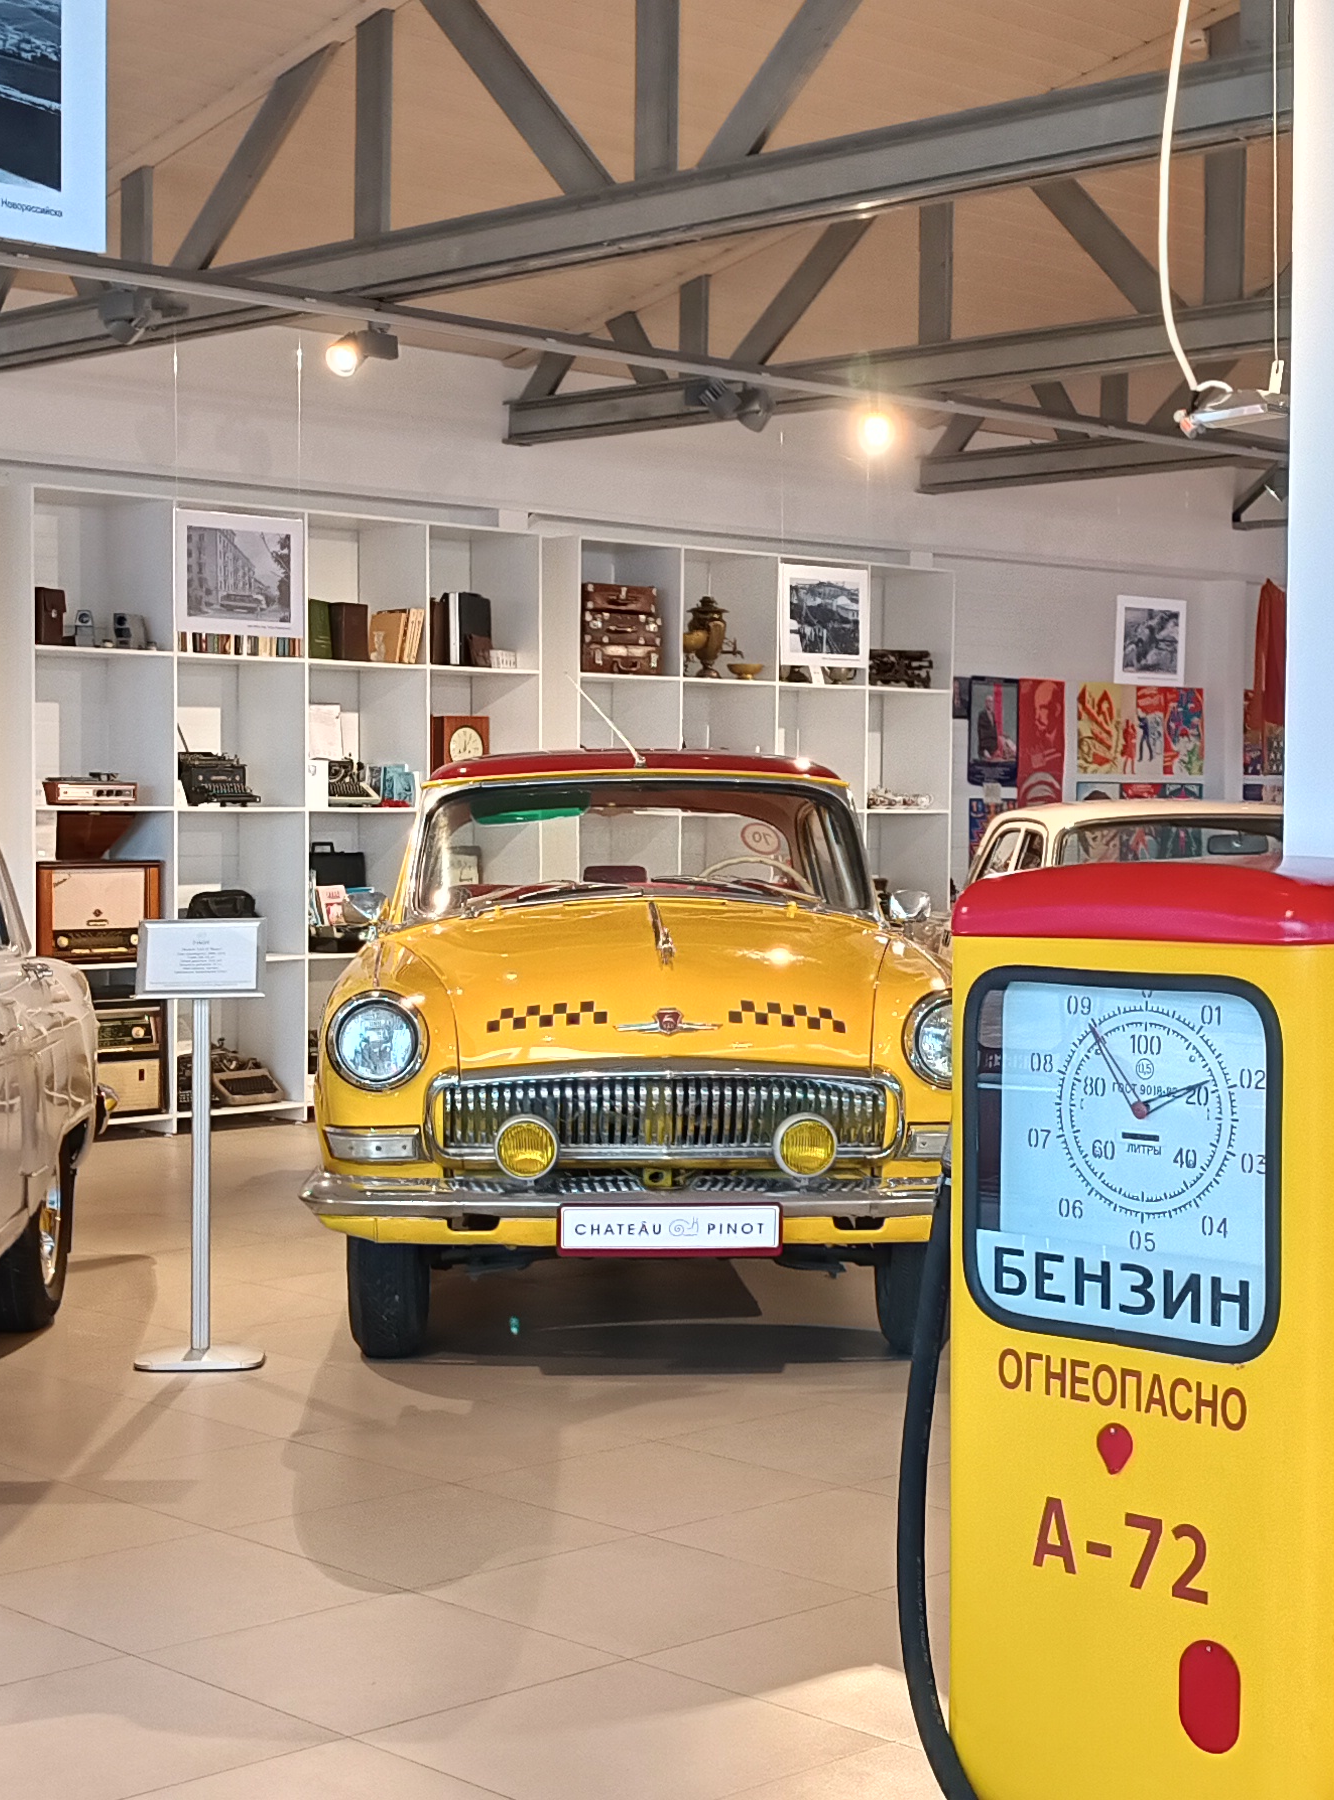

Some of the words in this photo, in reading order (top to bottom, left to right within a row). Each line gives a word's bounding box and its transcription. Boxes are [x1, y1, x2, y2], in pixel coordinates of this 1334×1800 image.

[0, 197, 63, 218] Новороссийска
[1067, 995, 1092, 1015] 09
[1201, 1005, 1222, 1025] 01
[1130, 1034, 1162, 1055] 100
[1030, 1052, 1053, 1072] 08
[1083, 1076, 1106, 1097] 80
[1112, 1081, 1137, 1093] ГОСТ
[1240, 1068, 1266, 1090] 02
[1186, 1086, 1209, 1106] 20
[1028, 1128, 1051, 1148] 07
[1092, 1139, 1115, 1160] 60
[1126, 1143, 1162, 1156] ЛИТРЫ
[1173, 1148, 1197, 1169] 40
[1241, 1152, 1266, 1174] 03
[1058, 1197, 1084, 1219] 06
[707, 1222, 765, 1235] PINOT
[1201, 1215, 1228, 1238] 04
[1129, 1230, 1156, 1252] 05
[993, 1245, 1250, 1332] БЕНЗИН
[998, 1348, 1248, 1432] ОГНЕОПАСНО
[1032, 1496, 1209, 1606] А-72
